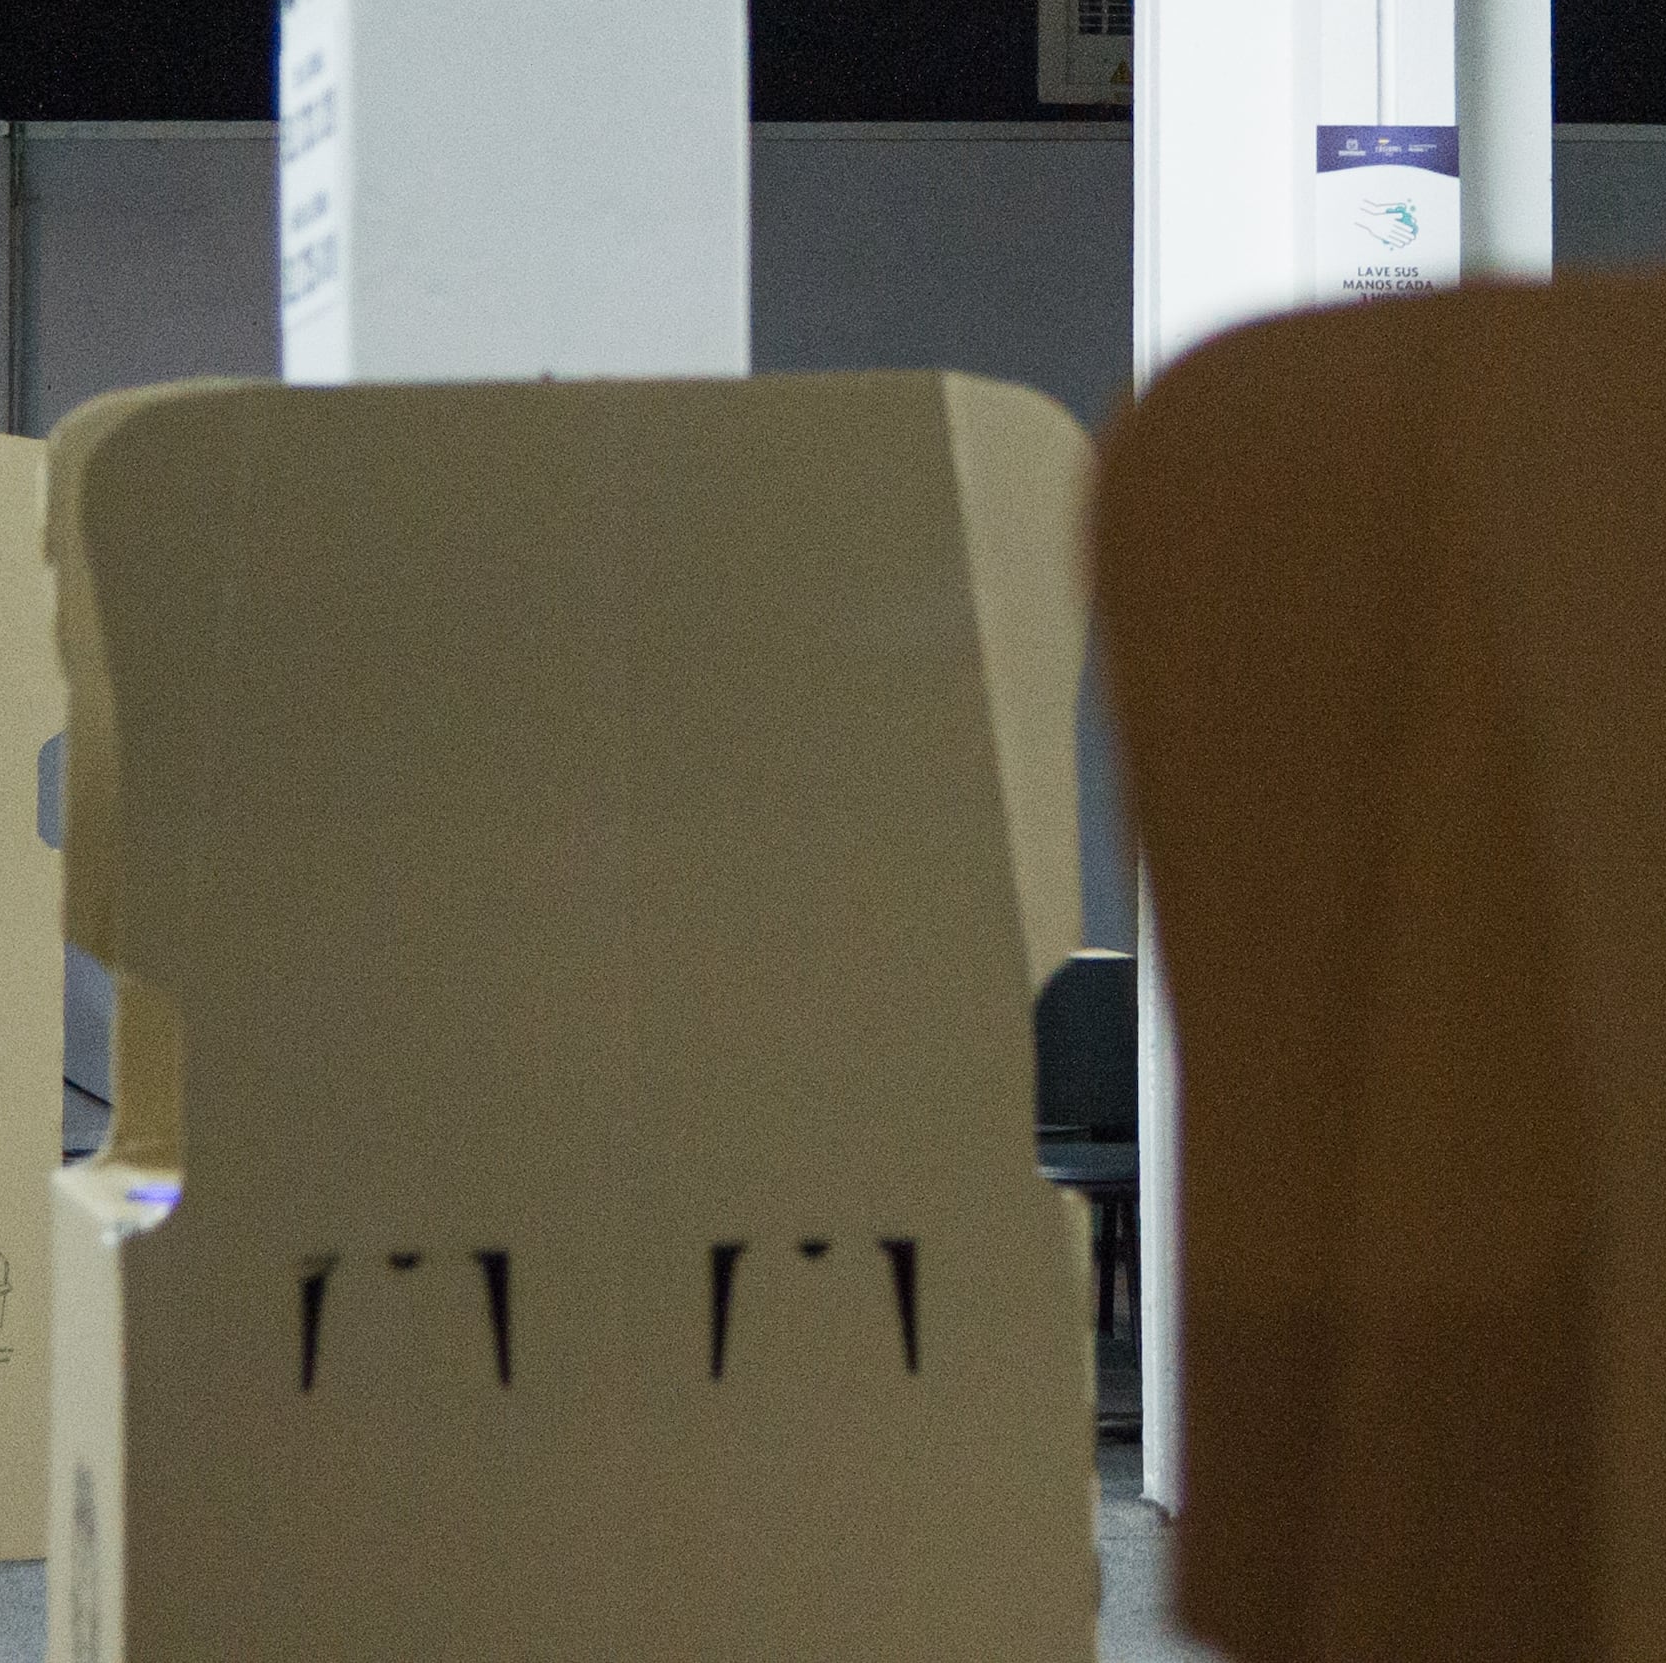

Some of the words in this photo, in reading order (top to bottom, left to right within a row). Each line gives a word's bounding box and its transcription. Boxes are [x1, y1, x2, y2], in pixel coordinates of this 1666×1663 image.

[1357, 266, 1390, 278] LAVE
[1394, 266, 1419, 278] SUS
[1343, 279, 1392, 290] MANOS
[1396, 279, 1433, 291] CADA
